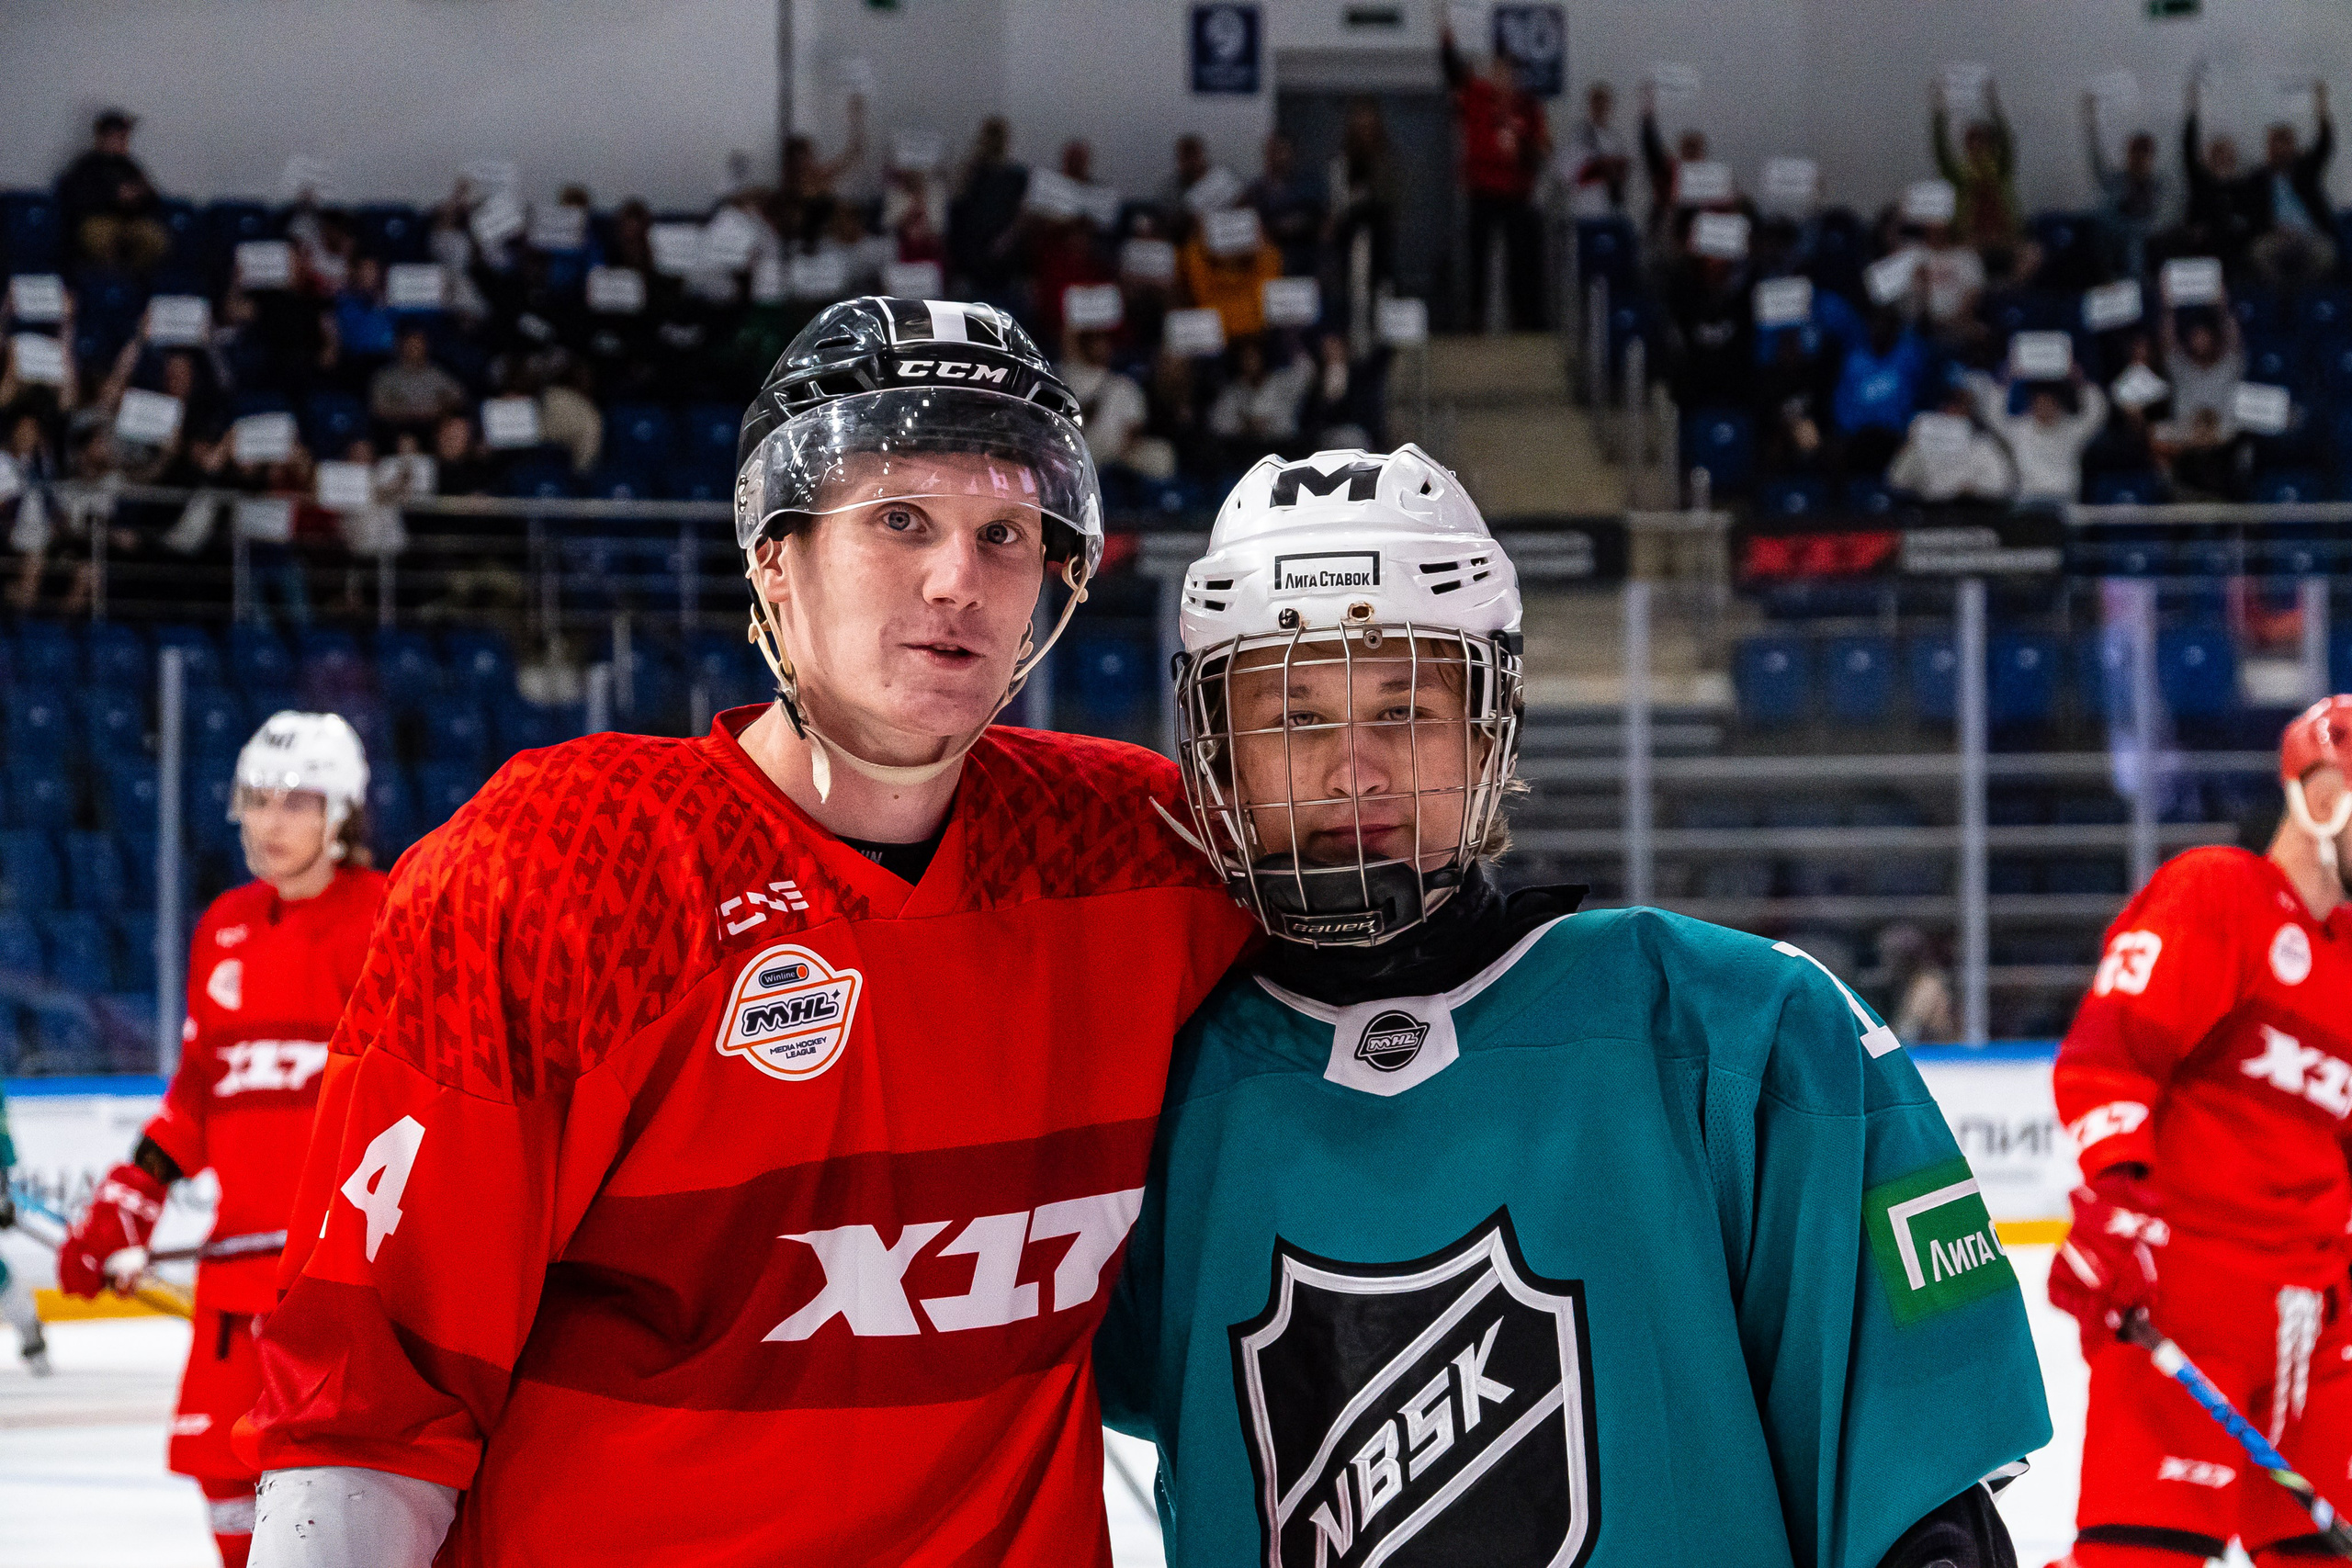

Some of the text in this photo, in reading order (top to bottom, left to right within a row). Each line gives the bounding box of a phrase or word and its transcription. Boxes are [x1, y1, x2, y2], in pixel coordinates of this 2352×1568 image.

[897, 359, 1009, 384] CCM
[1269, 461, 1383, 509] M
[763, 971, 797, 984] Winline
[744, 995, 837, 1034] MHL
[770, 1037, 827, 1055] MEDIA HOCKEY
[786, 1046, 817, 1059] LEAGUE
[1368, 1033, 1417, 1050] MHL
[319, 1114, 426, 1263] 4
[761, 1185, 1147, 1343] X17
